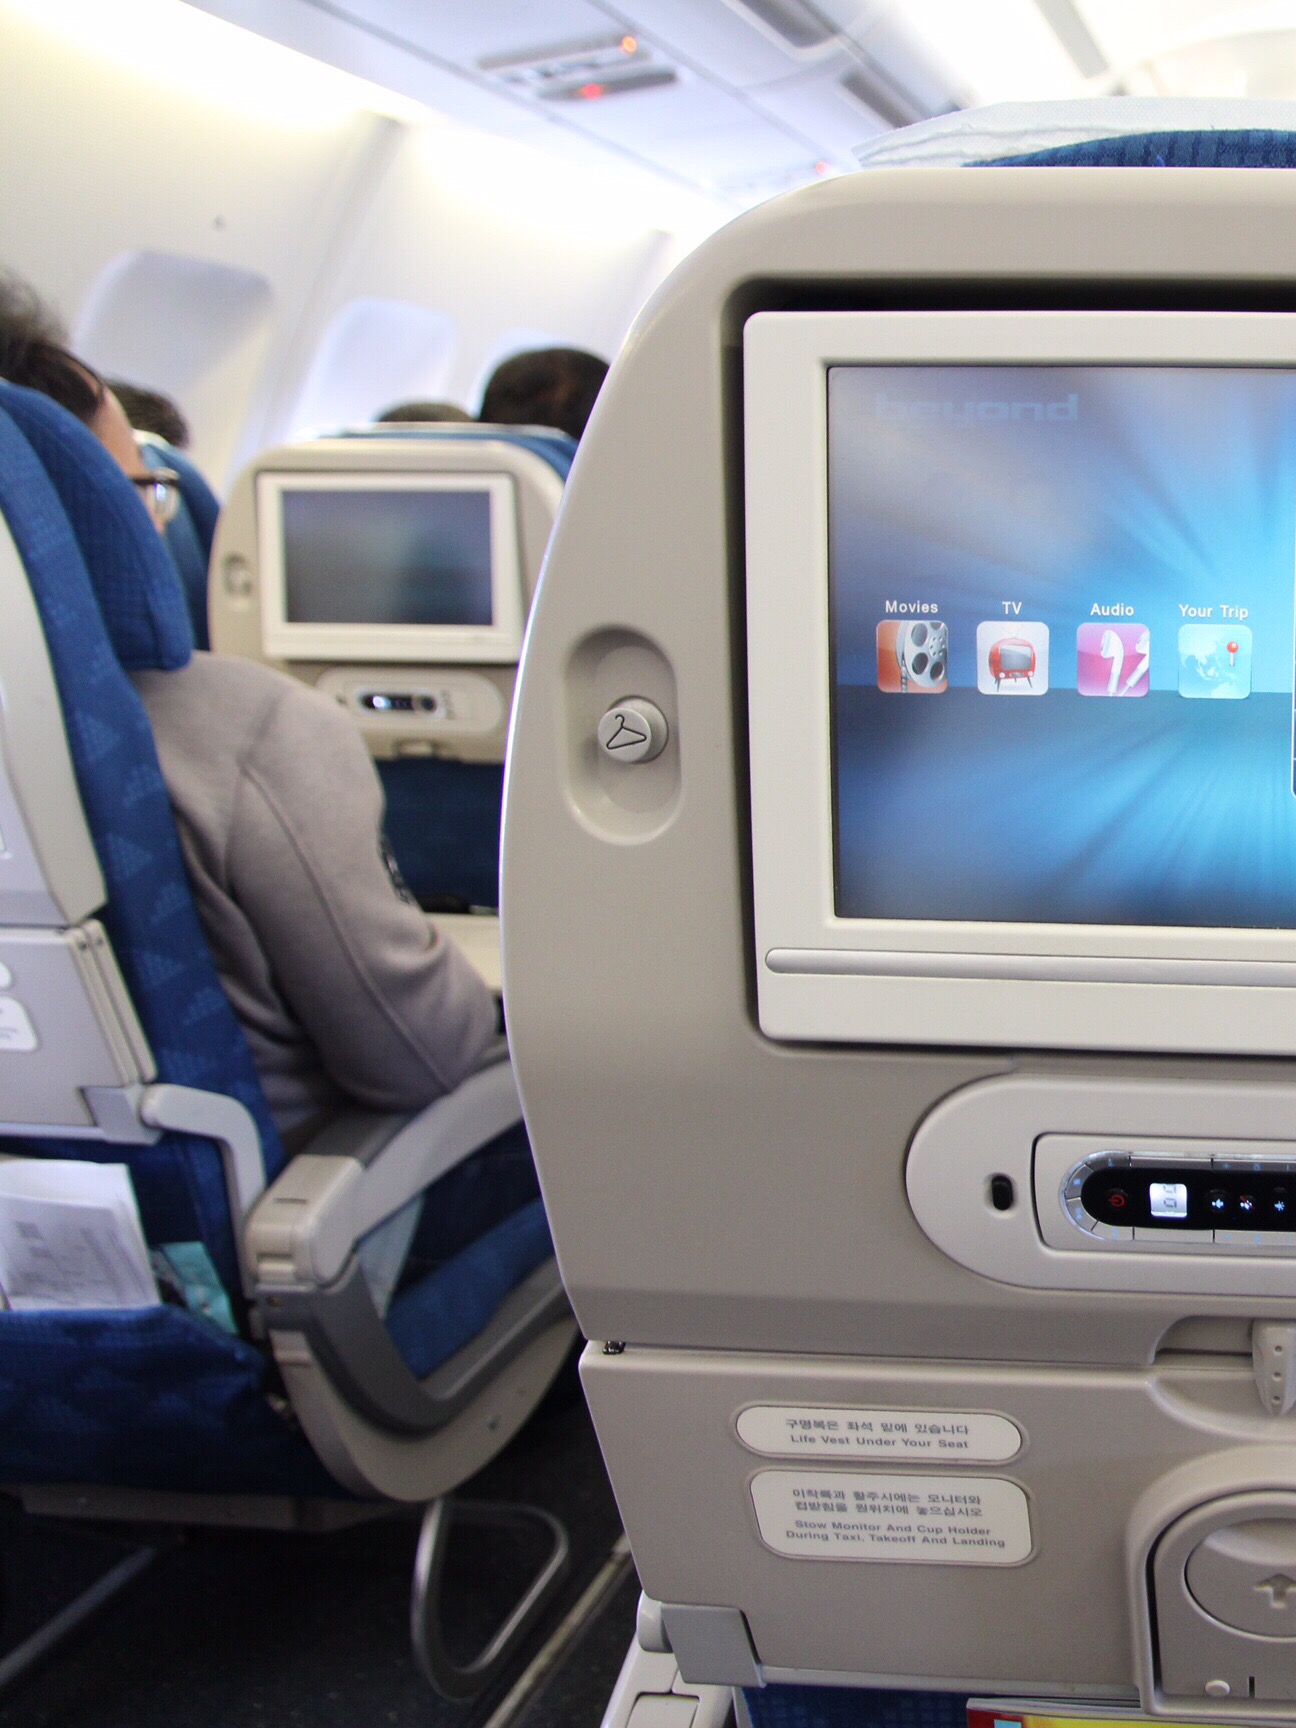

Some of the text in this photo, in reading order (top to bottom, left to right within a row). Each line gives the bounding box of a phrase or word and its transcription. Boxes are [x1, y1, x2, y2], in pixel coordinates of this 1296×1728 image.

[876, 393, 1078, 428] beyond
[885, 600, 939, 616] Movies
[1002, 602, 1022, 615] TV
[1090, 603, 1135, 617] Audio
[1178, 603, 1249, 622] Your Trip
[915, 1423, 970, 1435] 있습니다
[791, 1434, 969, 1449] Life Vest Under Your Seat
[795, 1520, 991, 1535] Stow Monitor And Cup Holder
[786, 1530, 1006, 1548] During Taxi, Takeoff And Landing
